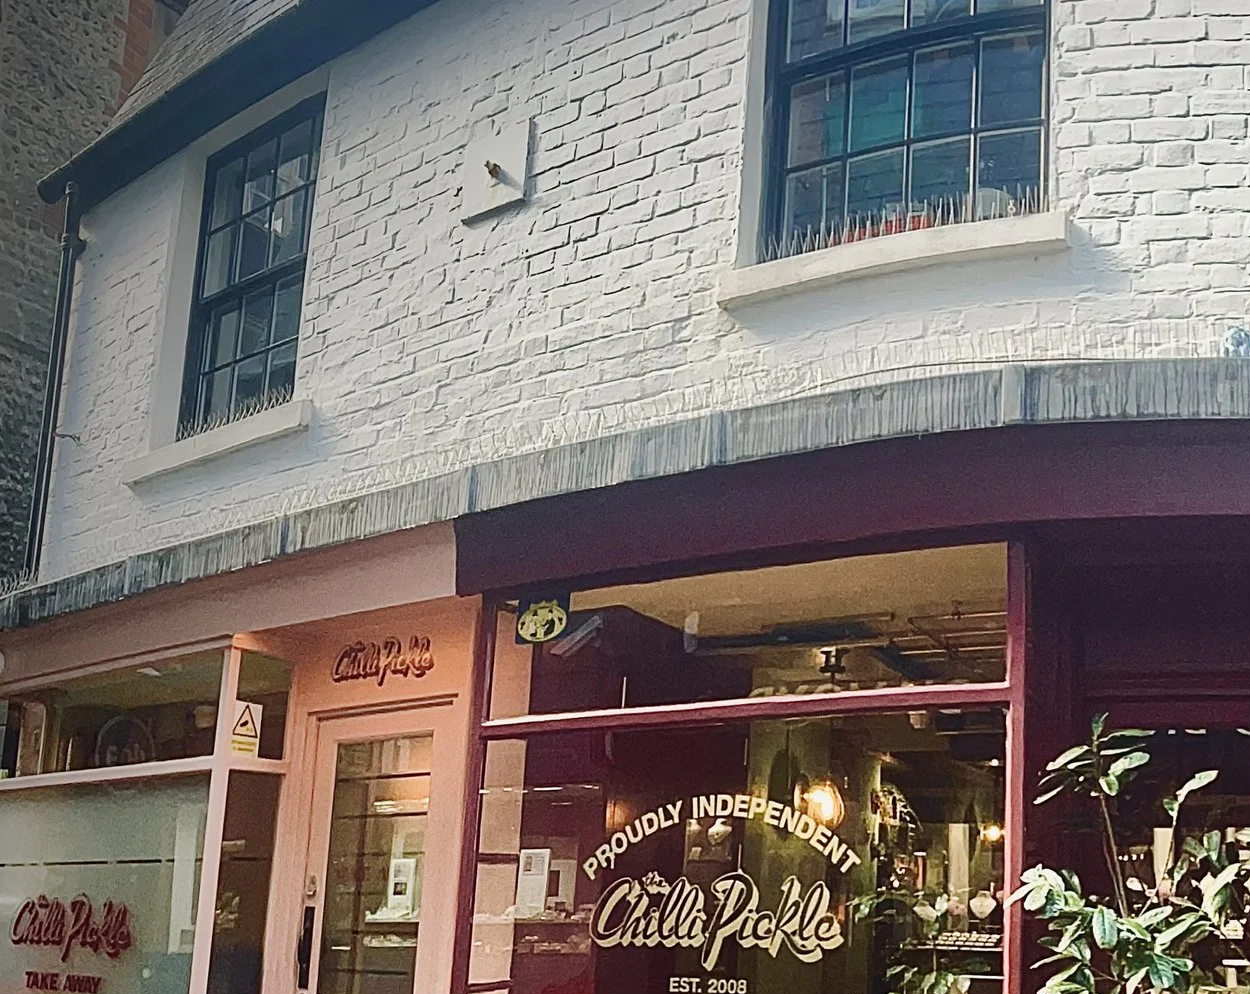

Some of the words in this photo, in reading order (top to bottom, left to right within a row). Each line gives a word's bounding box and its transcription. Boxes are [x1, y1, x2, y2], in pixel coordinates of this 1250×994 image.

[582, 800, 683, 881] PROUDLY
[692, 794, 862, 874] INDEPENDENT
[642, 871, 671, 894] the
[11, 896, 66, 945] Chilli
[61, 892, 133, 962] Pickle
[590, 876, 708, 948] Chilli
[702, 868, 845, 972] Pickle
[25, 971, 60, 991] TAKE
[62, 974, 102, 994] AWAY
[669, 977, 702, 994] EST.
[707, 979, 748, 994] 2008
